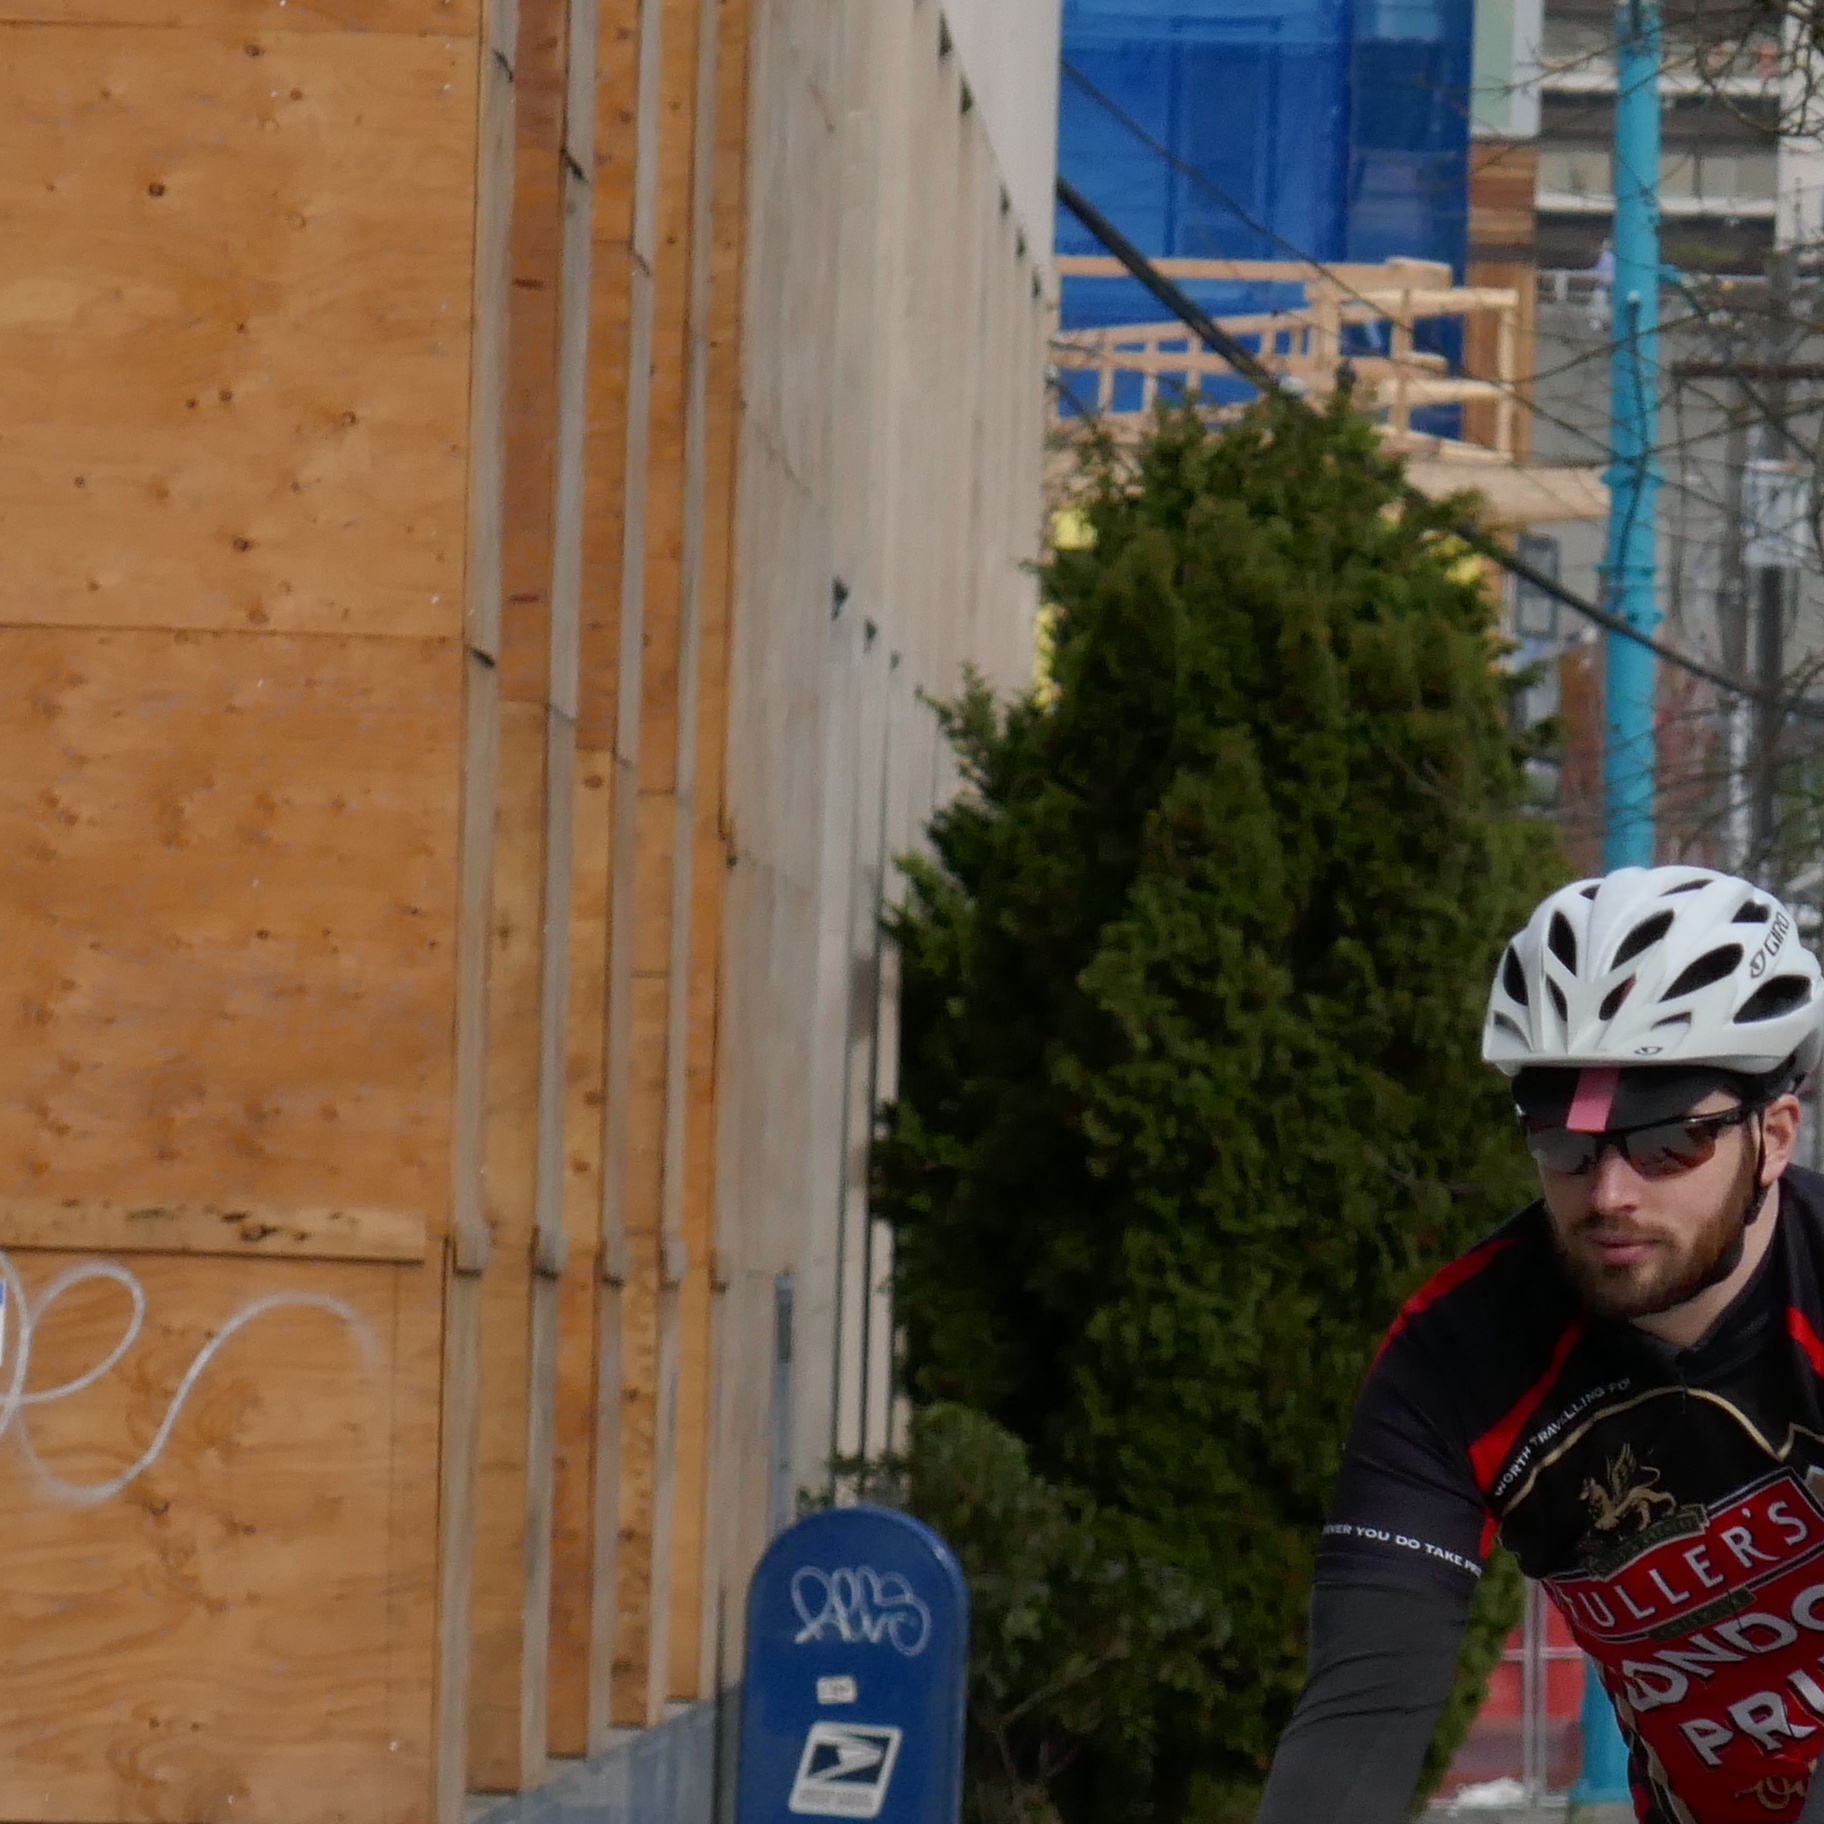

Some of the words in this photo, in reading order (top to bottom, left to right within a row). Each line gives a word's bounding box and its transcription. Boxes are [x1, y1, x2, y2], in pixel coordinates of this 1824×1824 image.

[1763, 910, 1790, 957] GIRO
[1494, 1445, 1532, 1497] WORTH
[1529, 1386, 1606, 1447] TRAVELLING
[1356, 1526, 1390, 1541] YOU
[1395, 1535, 1421, 1549] DO
[1425, 1542, 1463, 1566] TAKE
[1578, 1500, 1808, 1628] ULLER'S
